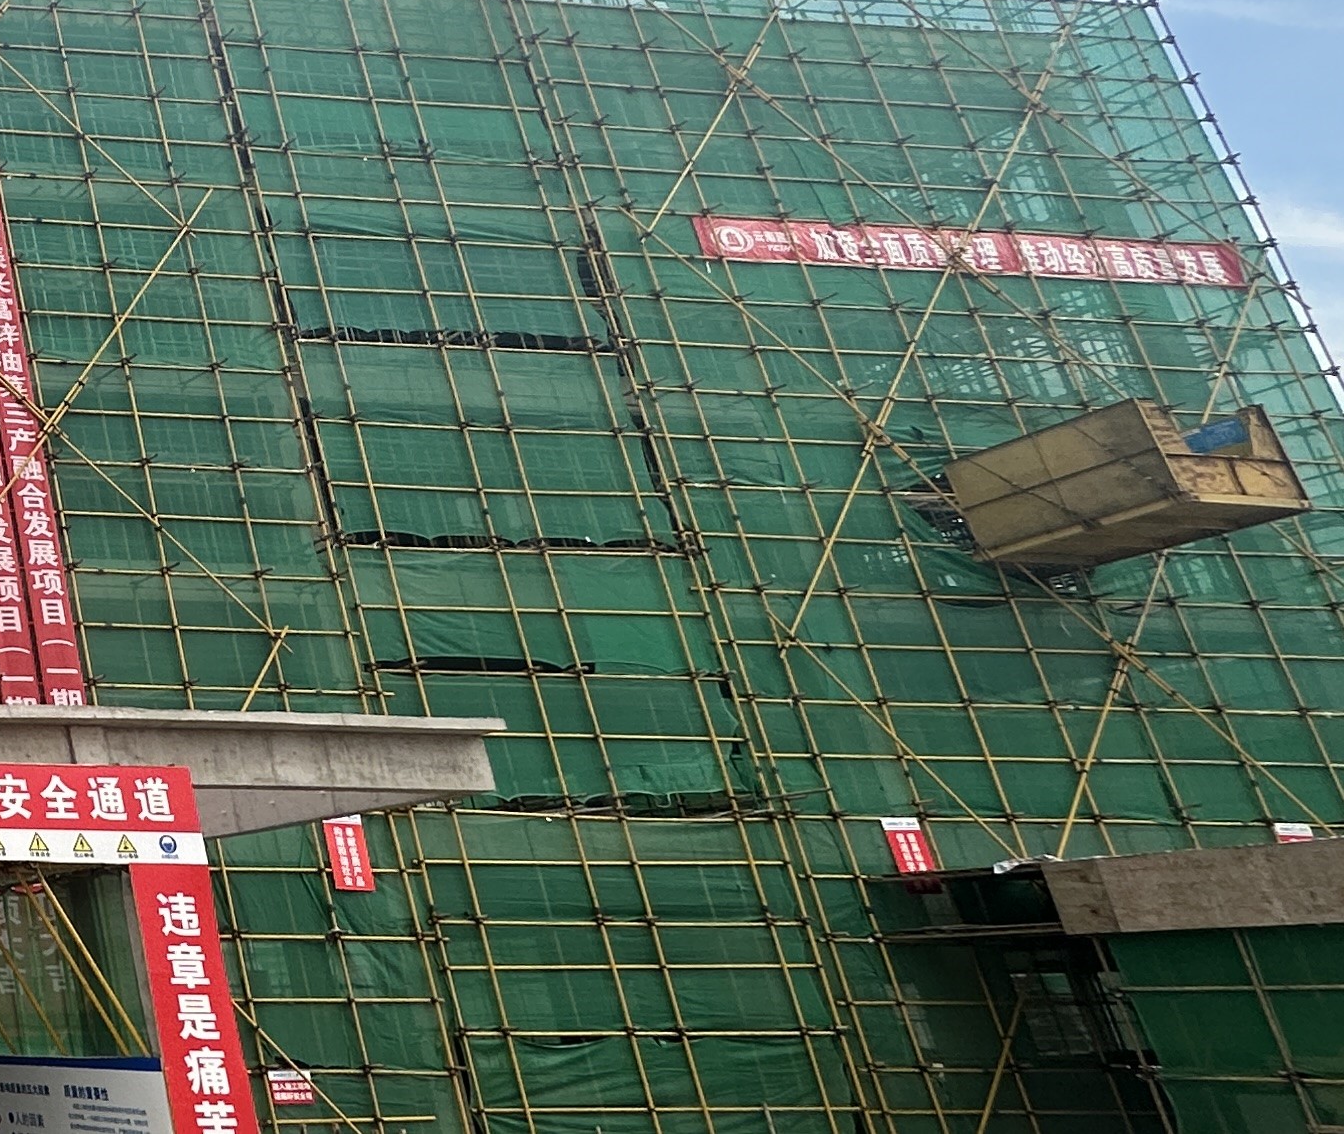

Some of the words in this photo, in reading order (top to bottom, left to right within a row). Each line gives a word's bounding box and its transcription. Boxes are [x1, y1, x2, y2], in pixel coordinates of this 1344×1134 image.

[1017, 237, 1230, 284] 推动经济高质量发展
[156, 892, 238, 1134] 违章是痛苦
